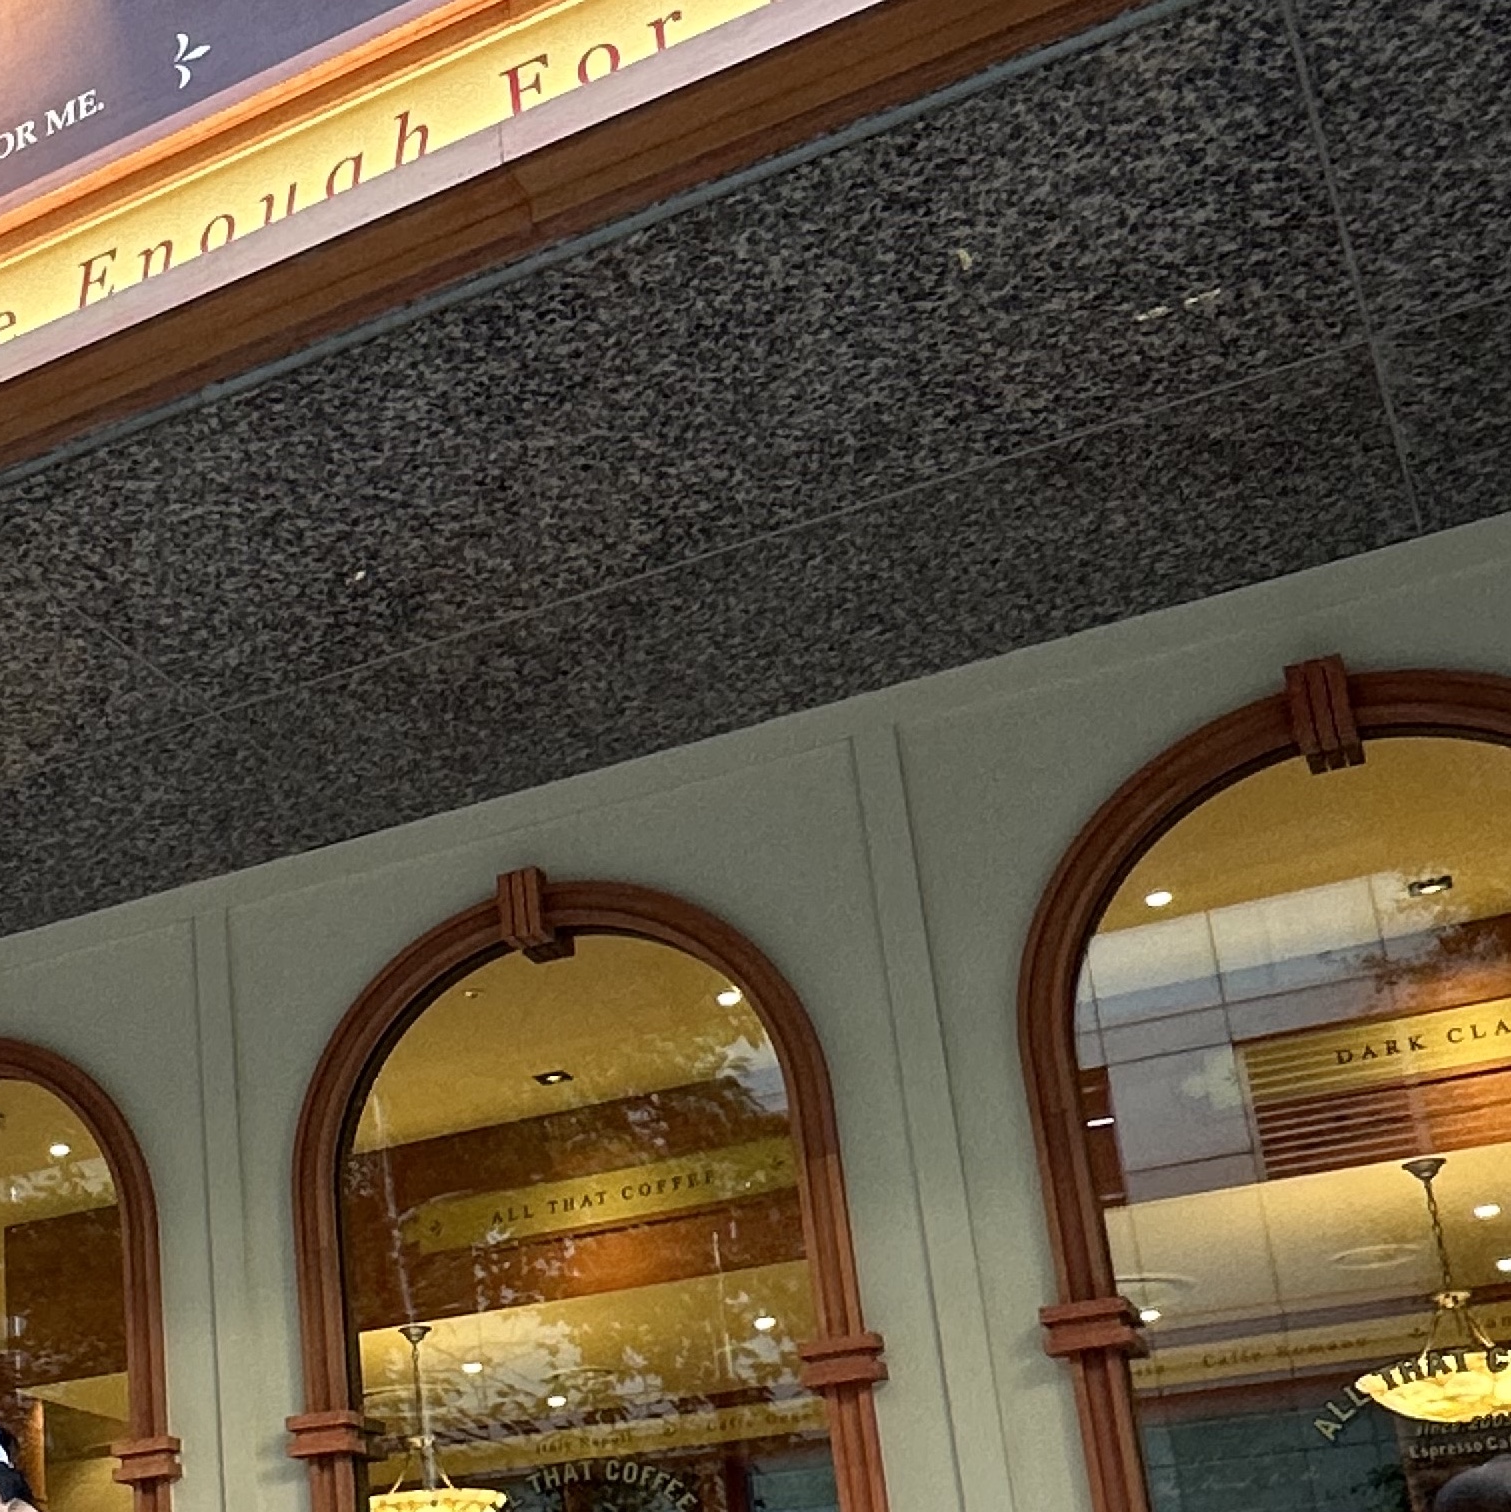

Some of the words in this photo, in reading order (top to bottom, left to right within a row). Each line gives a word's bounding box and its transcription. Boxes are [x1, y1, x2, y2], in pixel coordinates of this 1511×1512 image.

[498, 9, 683, 118] For
[43, 88, 106, 136] ME.
[1335, 1033, 1428, 1065] DARK
[491, 1204, 535, 1226] ALL
[546, 1190, 608, 1215] THAT
[620, 1169, 715, 1201] COFFEE
[1313, 1385, 1372, 1441] ALL
[1374, 1350, 1469, 1391] THAT
[525, 1459, 594, 1494] THAT
